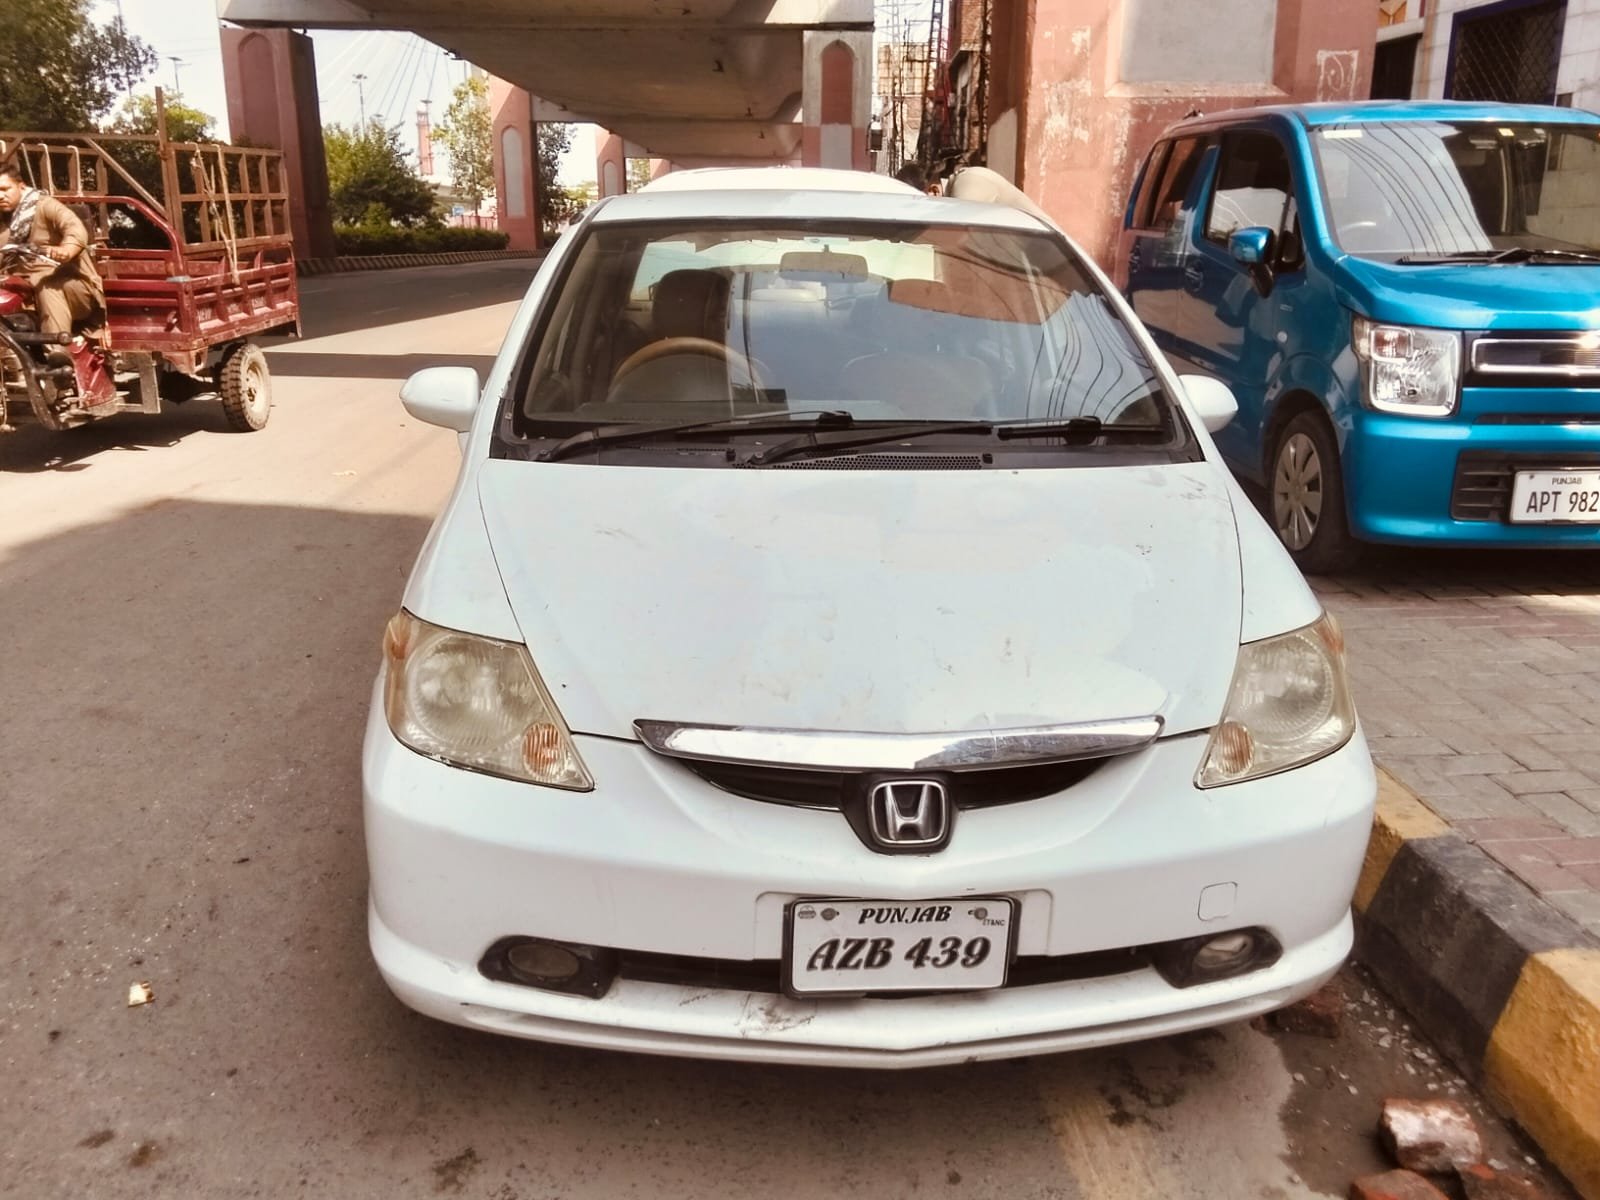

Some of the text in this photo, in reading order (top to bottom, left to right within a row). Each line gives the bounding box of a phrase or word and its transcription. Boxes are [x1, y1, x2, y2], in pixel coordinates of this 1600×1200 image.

[1552, 477, 1583, 485] PUNJAB
[1526, 491, 1600, 513] APT 982
[858, 905, 953, 925] PUNJAB
[806, 936, 991, 971] AZB 439
